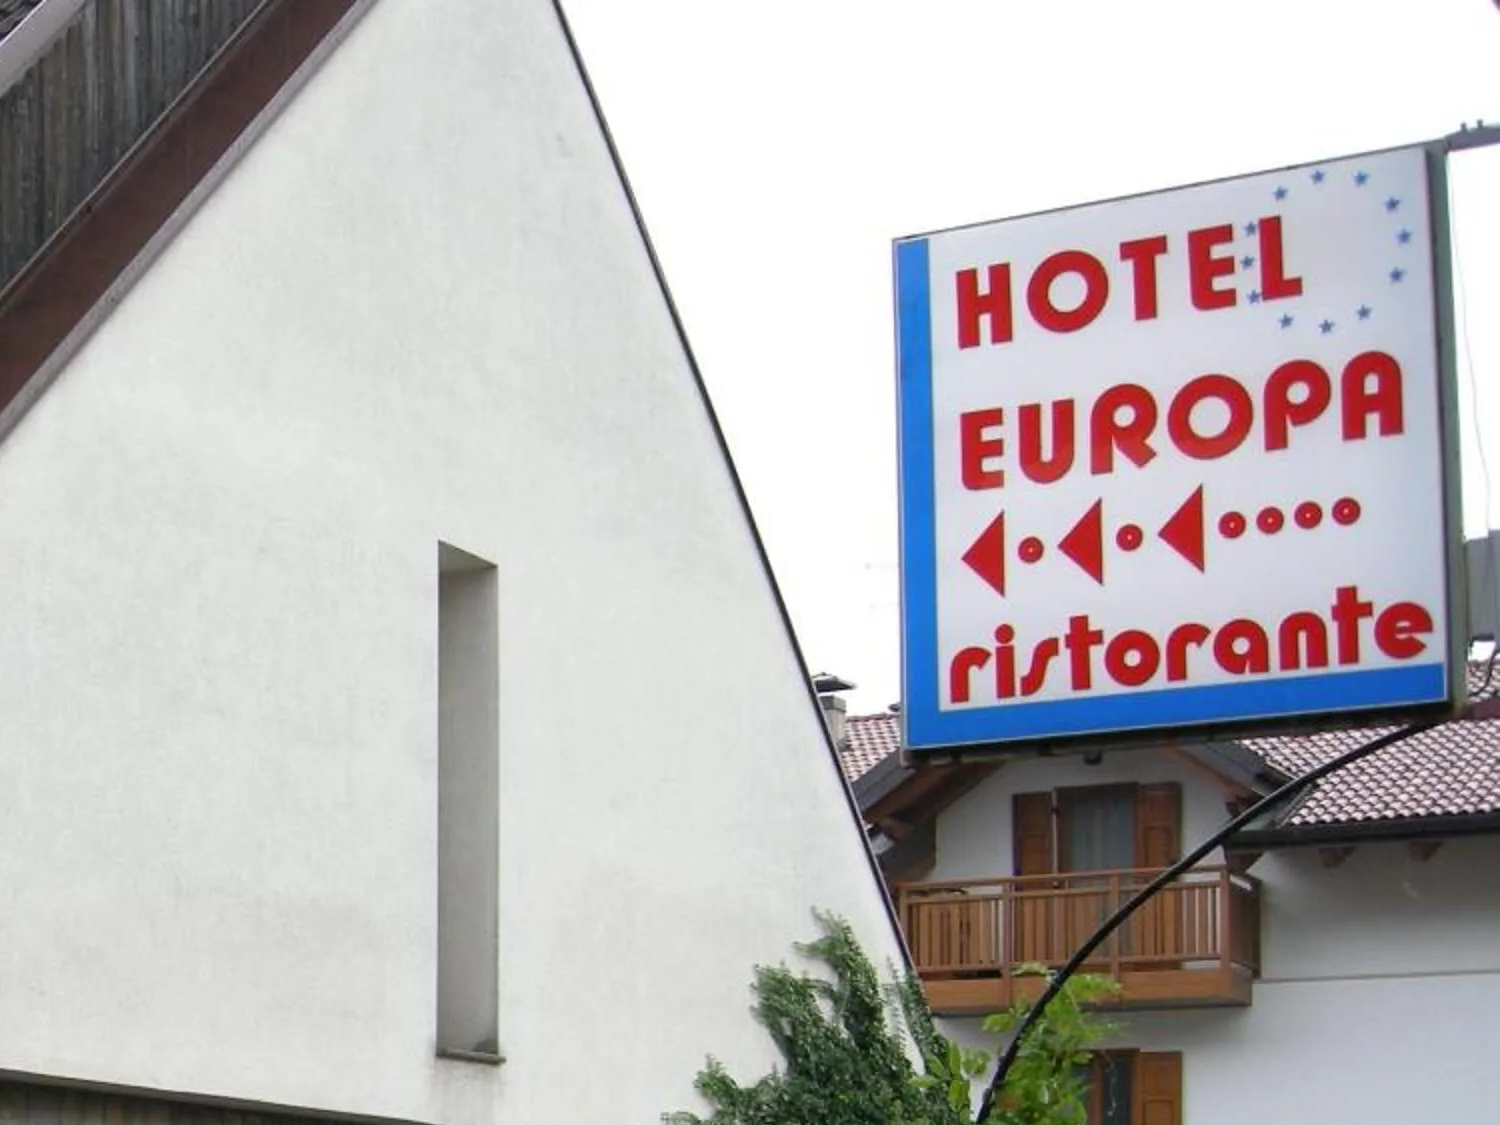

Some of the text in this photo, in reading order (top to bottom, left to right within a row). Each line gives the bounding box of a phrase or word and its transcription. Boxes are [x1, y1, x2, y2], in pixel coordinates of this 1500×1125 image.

[956, 215, 1304, 348] HOTEL
[960, 351, 1405, 491] EUROPA
[949, 585, 1435, 704] ristorante
